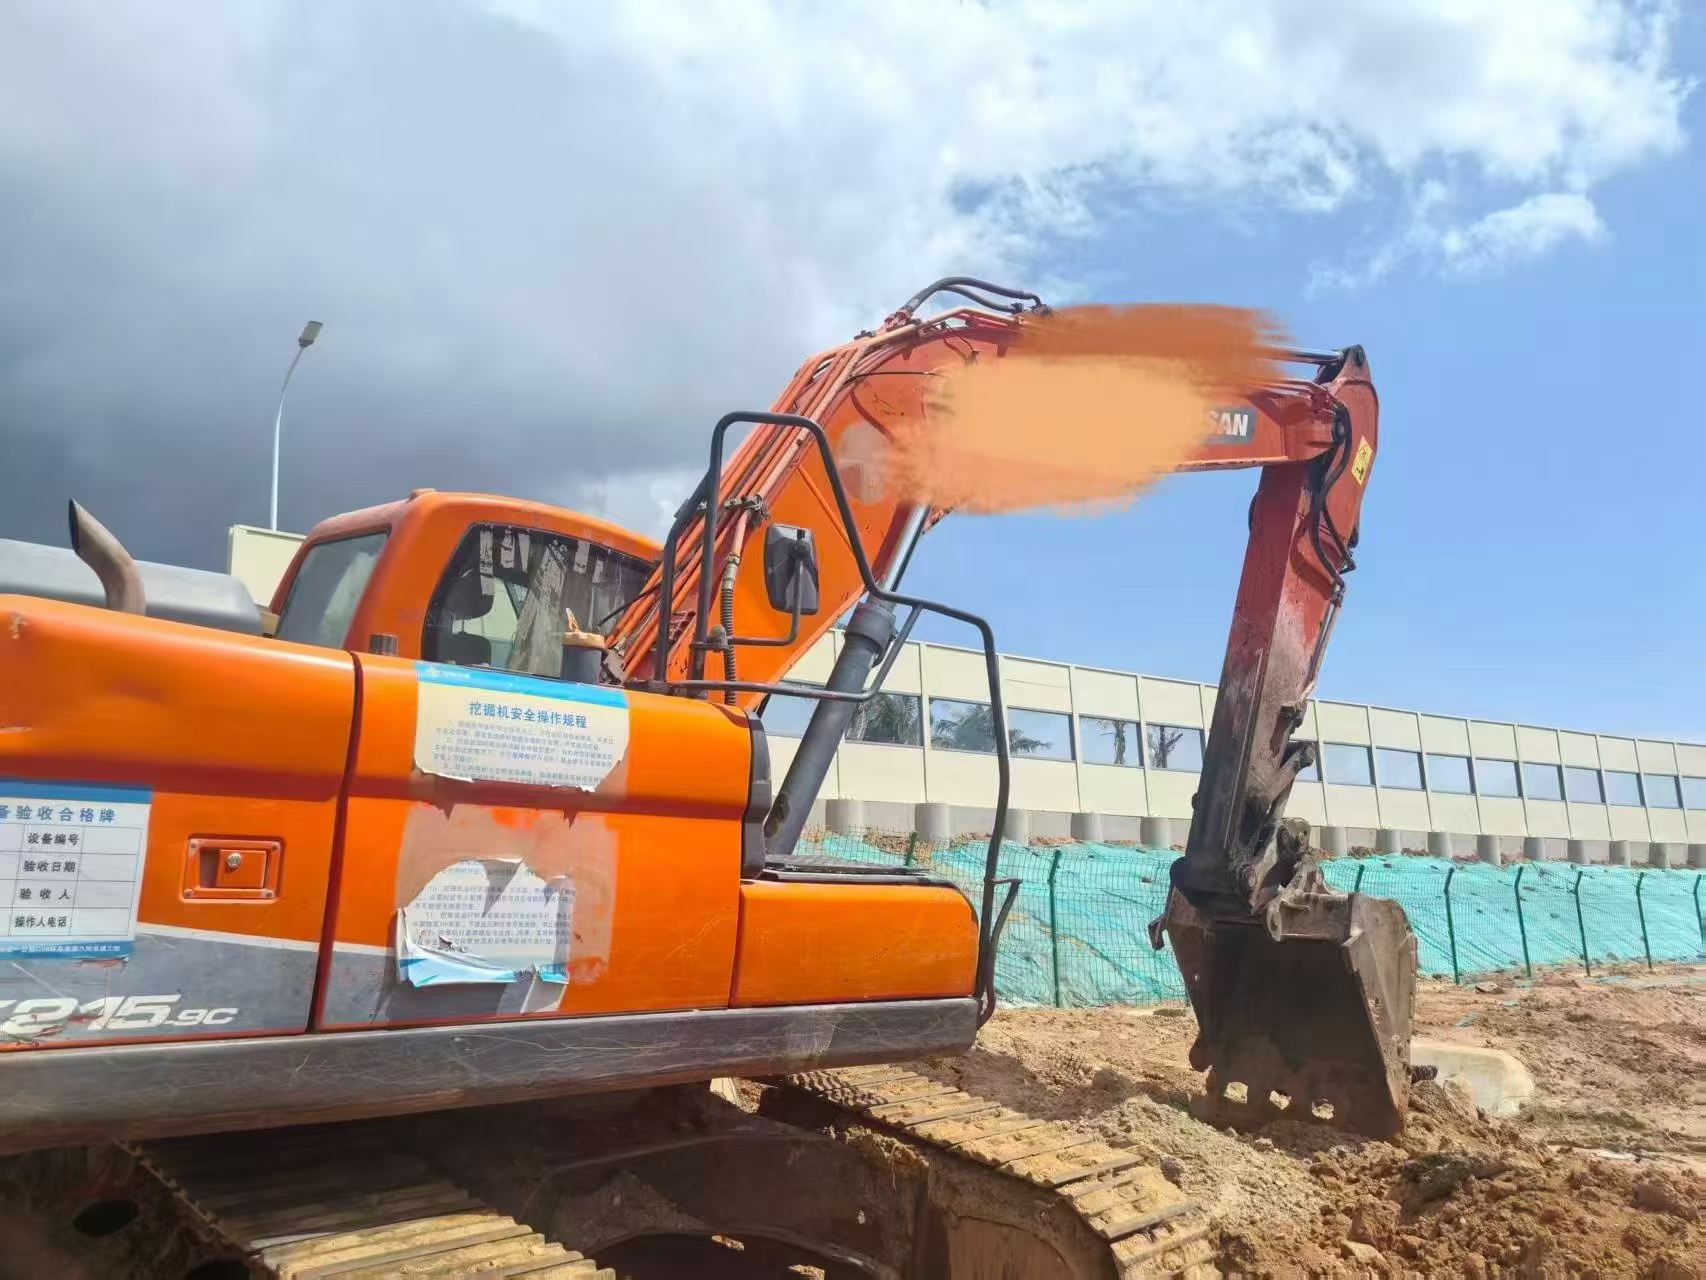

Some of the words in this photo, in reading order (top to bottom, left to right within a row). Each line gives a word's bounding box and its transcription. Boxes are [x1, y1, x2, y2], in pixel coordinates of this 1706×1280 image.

[469, 702, 588, 728] 挖掘机安全操作规程
[28, 832, 79, 846] 设备编号
[23, 860, 77, 873] 验收日期
[20, 888, 70, 901] 验收人
[14, 916, 68, 928] 操作人电话
